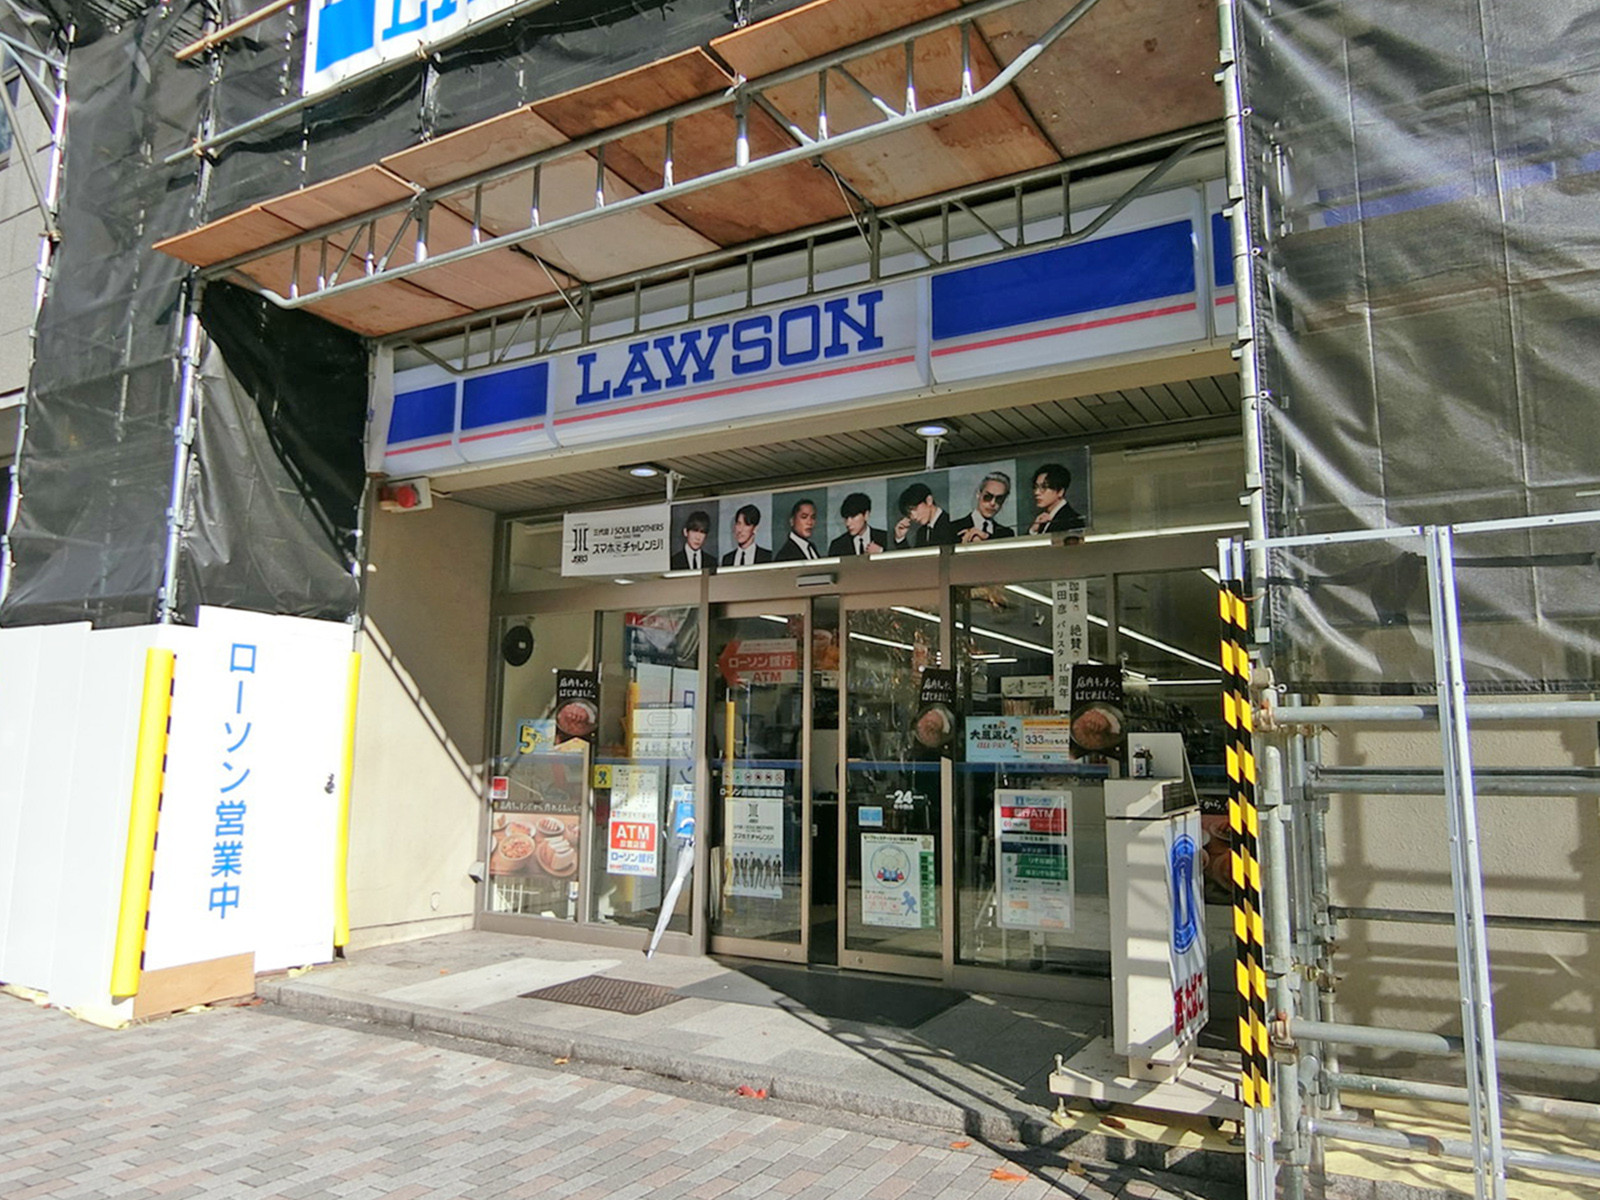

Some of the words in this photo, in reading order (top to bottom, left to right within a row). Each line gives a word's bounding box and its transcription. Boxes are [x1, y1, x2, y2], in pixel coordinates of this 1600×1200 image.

[576, 290, 883, 405] LAWSON
[728, 655, 794, 669] ローソン銀行
[752, 671, 782, 682] ATM
[208, 642, 258, 920] ローソン営業中
[894, 789, 914, 804] 24
[616, 824, 650, 840] ATM
